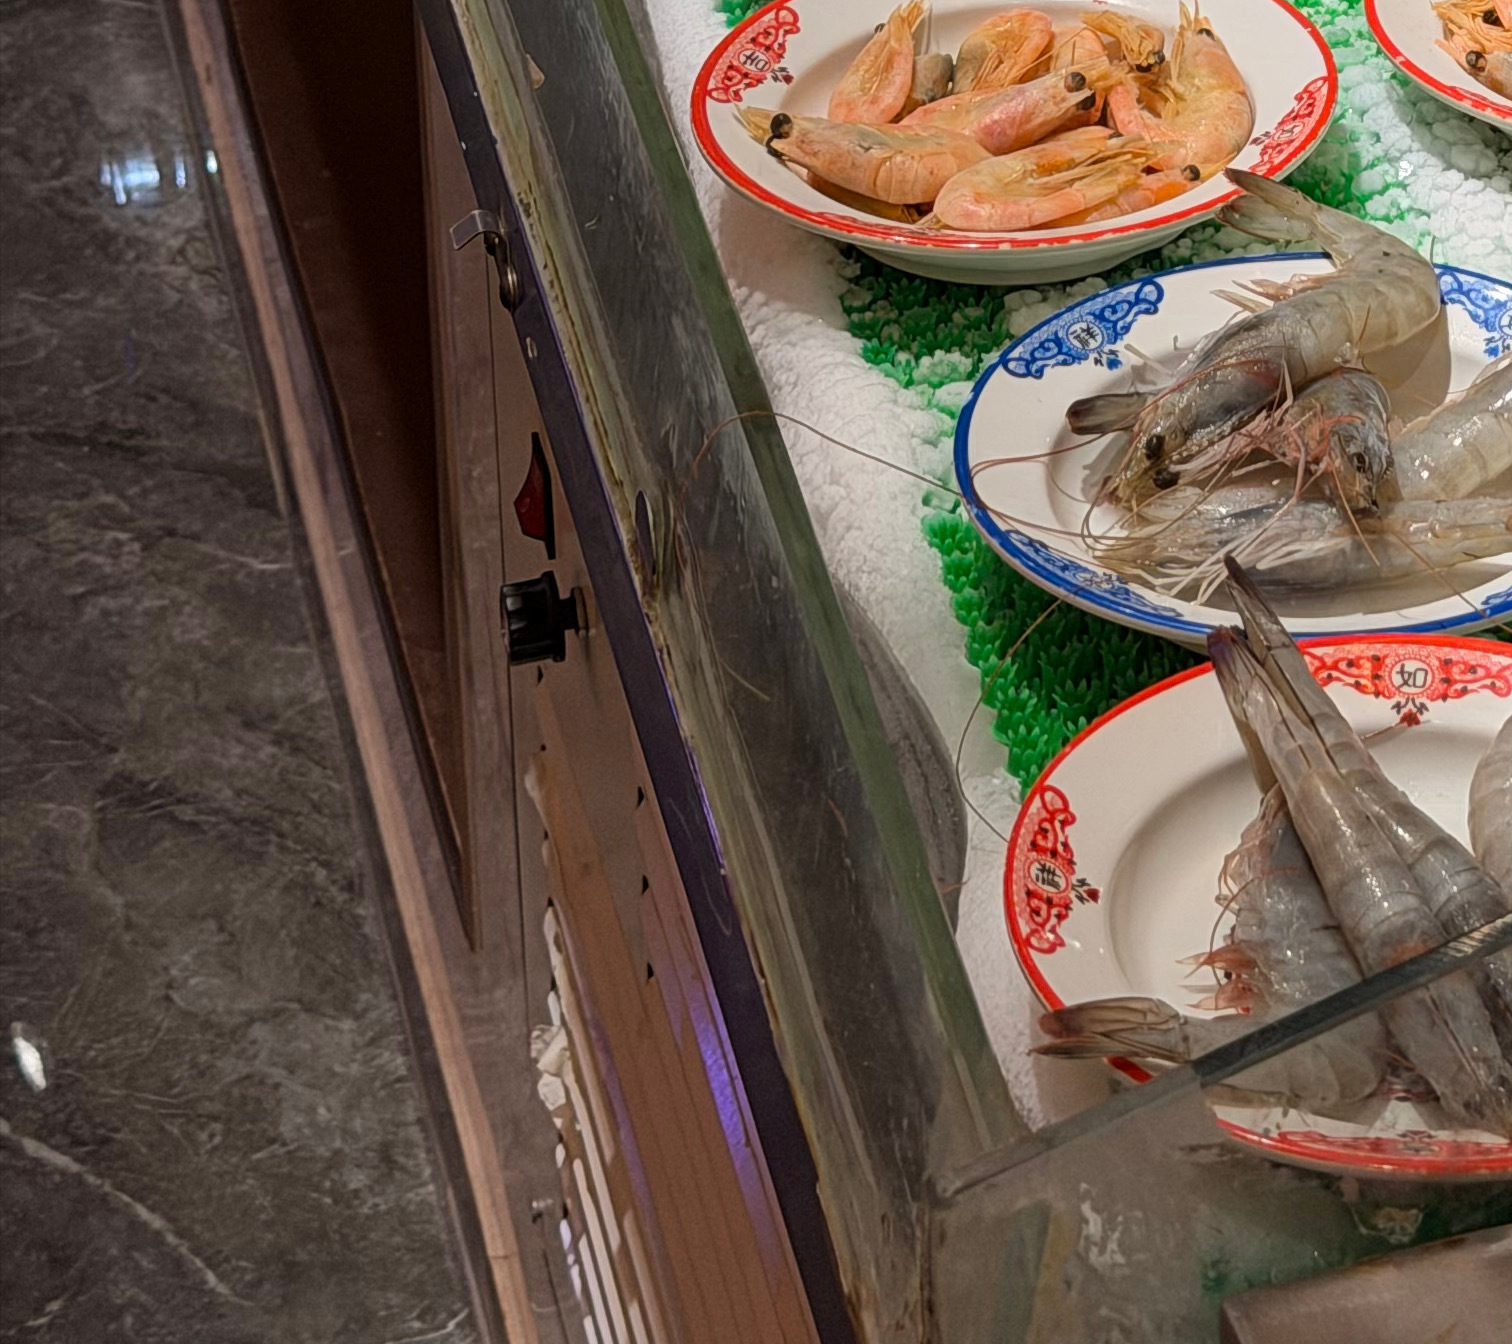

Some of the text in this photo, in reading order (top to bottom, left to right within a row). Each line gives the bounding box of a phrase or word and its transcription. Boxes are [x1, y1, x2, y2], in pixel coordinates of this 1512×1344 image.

[741, 51, 770, 72] 吉
[1070, 323, 1102, 350] 祥
[1396, 663, 1428, 690] 如
